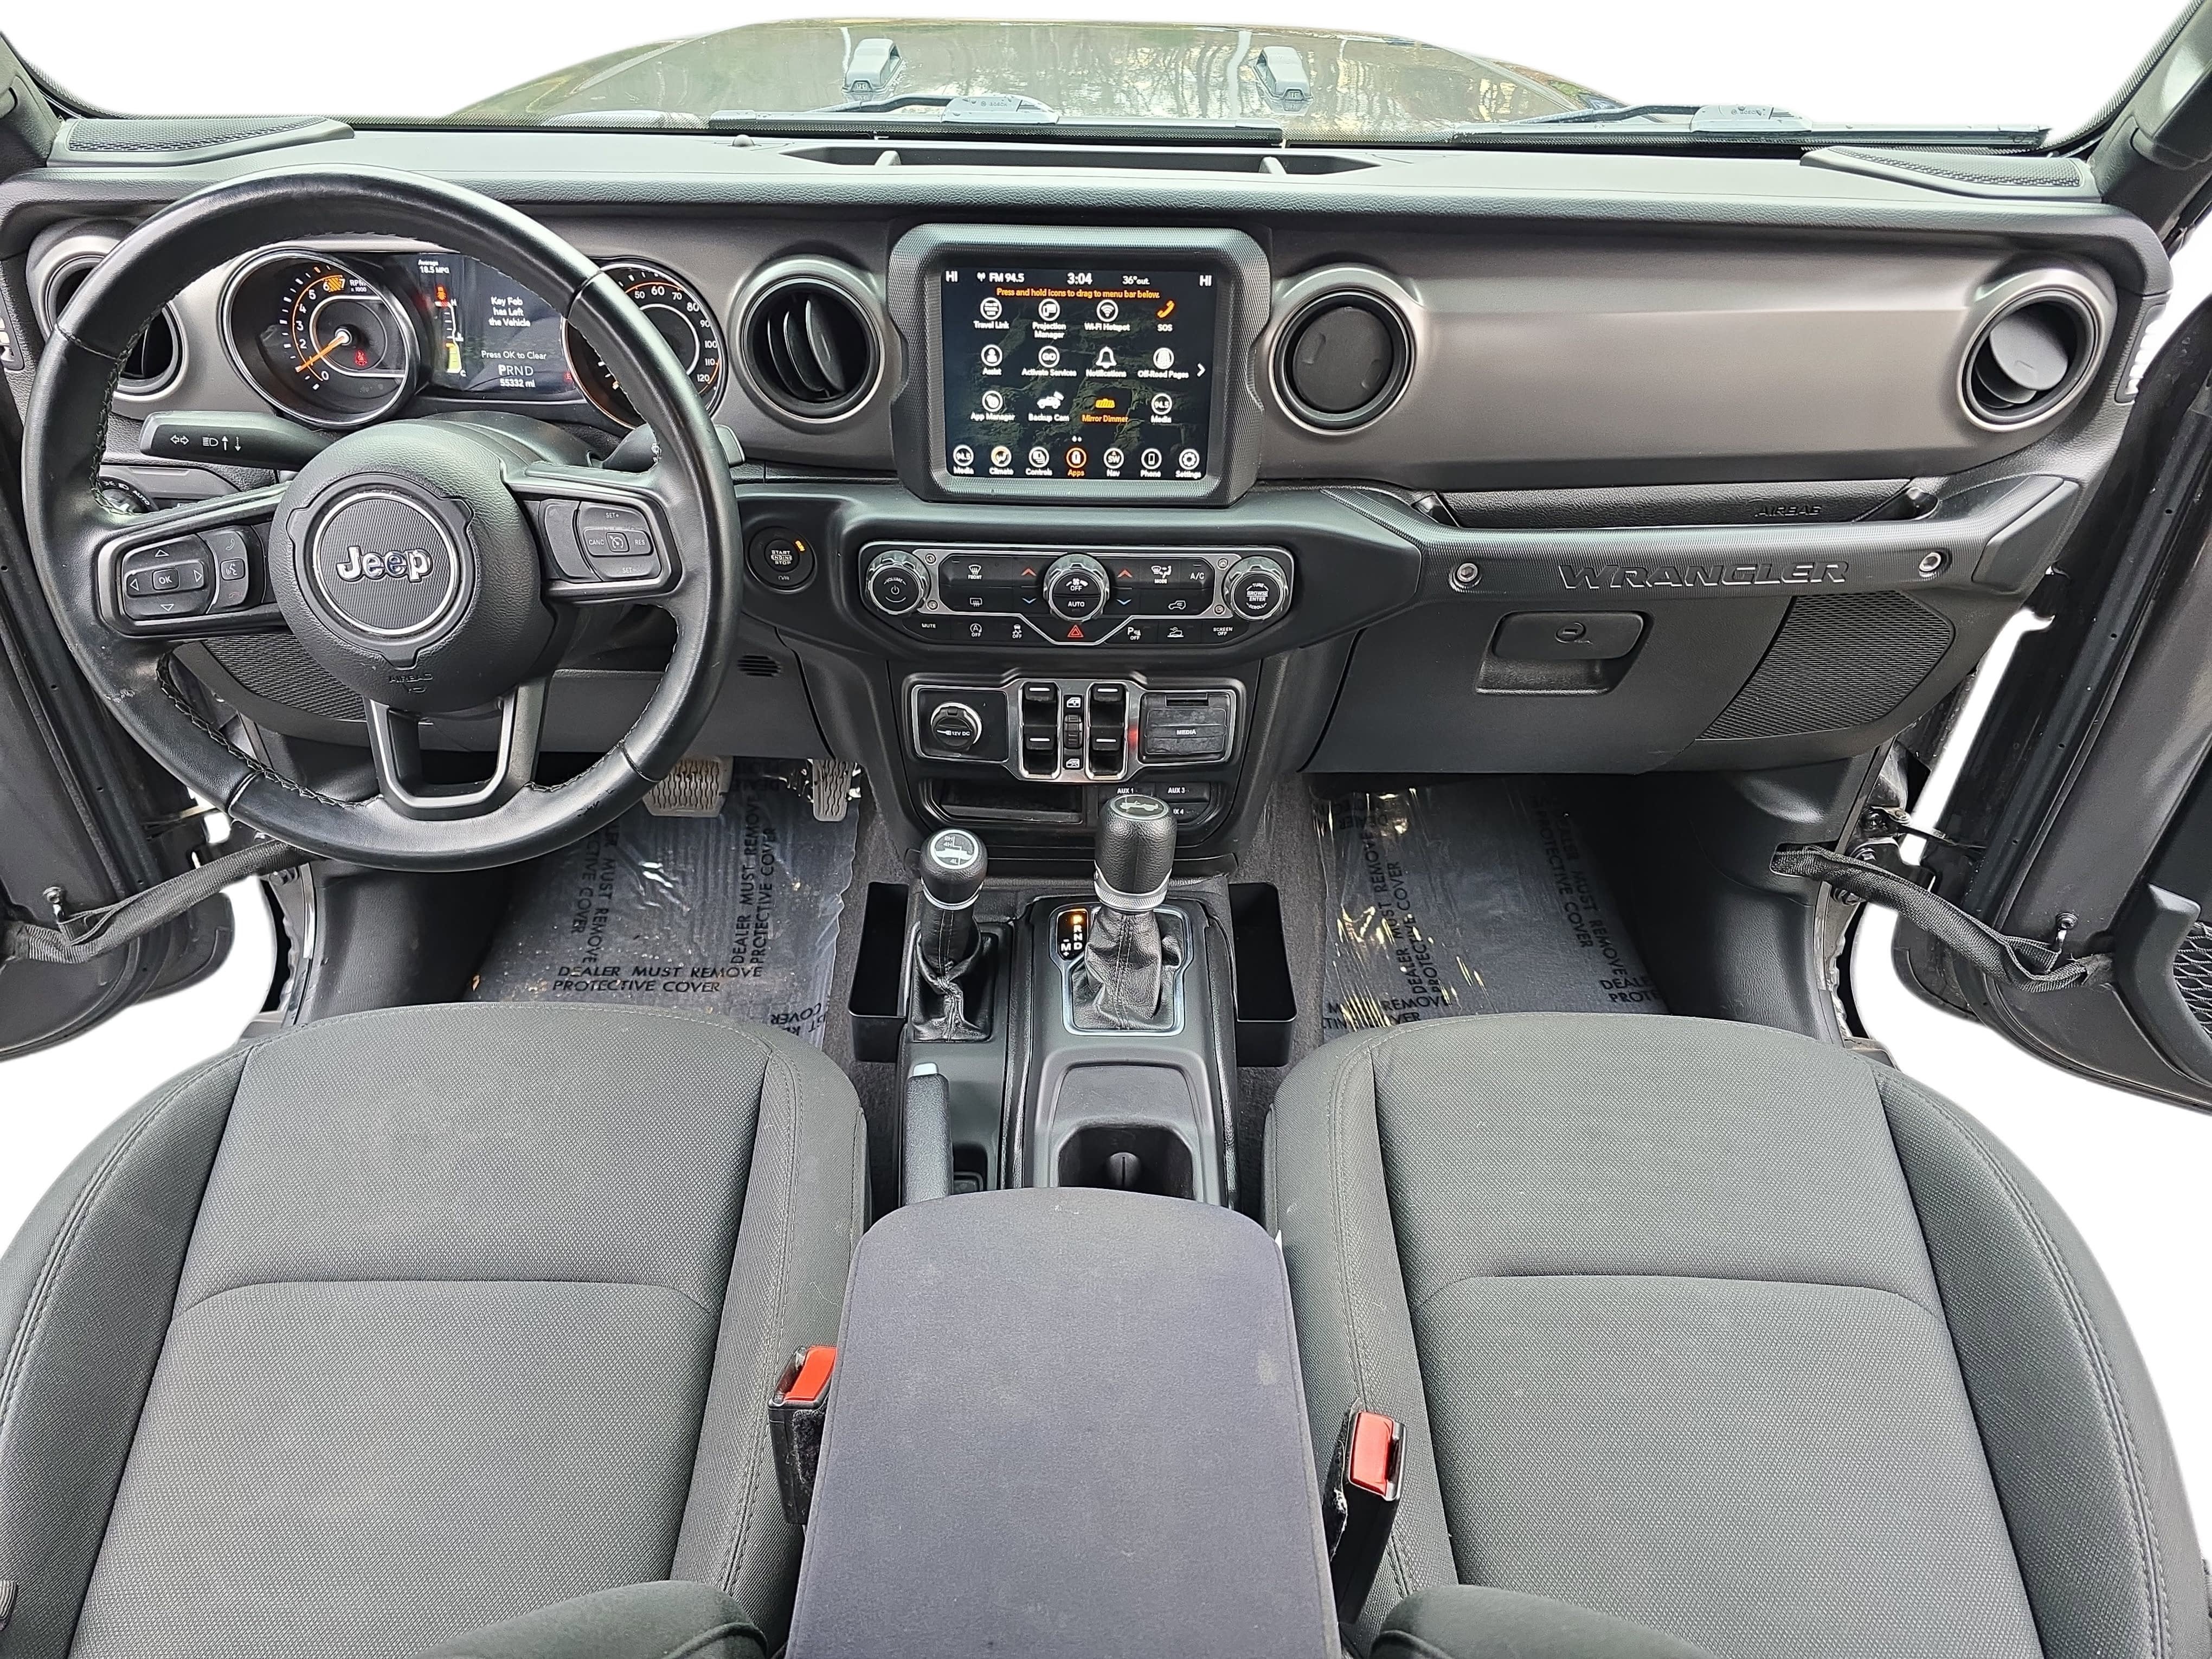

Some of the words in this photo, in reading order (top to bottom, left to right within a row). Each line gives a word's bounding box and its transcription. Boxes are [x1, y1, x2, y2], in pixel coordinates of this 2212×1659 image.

[946, 271, 958, 281] HI
[989, 273, 1003, 282] FM
[1005, 273, 1024, 282] 94.5
[1067, 273, 1092, 285] 3:04
[1199, 275, 1212, 286] HI
[323, 283, 330, 292] 6
[340, 278, 345, 288] 7
[308, 290, 316, 299] 5
[651, 286, 665, 295] 60
[996, 288, 1014, 296] Press
[1076, 290, 1092, 298] drag
[672, 292, 683, 300] 70
[491, 297, 506, 306] Key
[507, 297, 523, 305] Fob
[299, 303, 306, 314] 4
[493, 307, 507, 316] has
[508, 307, 524, 316] Left
[687, 302, 699, 312] 80
[296, 320, 304, 331] 3
[488, 318, 503, 326] the
[504, 318, 531, 327] Vehicle
[700, 320, 710, 328] 90
[995, 321, 1009, 329] Link
[1032, 322, 1066, 330] Projection
[1084, 323, 1102, 331] Wi-Fi
[1103, 323, 1130, 332] Hotspot
[1158, 324, 1173, 332] SOS
[1034, 330, 1065, 339] Manager
[300, 339, 307, 348] 2
[481, 350, 501, 359] Press
[527, 351, 547, 360] Clear
[321, 371, 329, 380] 0
[1021, 368, 1049, 376] Activate
[1086, 369, 1127, 378] Notifications
[1137, 370, 1167, 378] Off-Road
[1168, 371, 1189, 379] Pages
[697, 374, 710, 382] 120
[525, 380, 536, 388] mi
[970, 411, 985, 421] App
[986, 413, 1015, 422] Manager
[1028, 414, 1052, 422] Backup
[1108, 455, 1120, 464] SW
[953, 466, 974, 474] Media
[989, 467, 1014, 475] Climate
[1068, 469, 1084, 477] Apps
[1175, 471, 1201, 479] Settings
[132, 490, 150, 506] AUTO
[336, 545, 433, 583] Jeep
[158, 575, 172, 584] OK
[1558, 561, 1849, 589] WRANGLER
[744, 796, 760, 855] REMOVE
[761, 828, 776, 876] COVER
[599, 858, 615, 900] MUST
[739, 865, 755, 907] MUST
[1388, 862, 1410, 911] COVER
[571, 887, 594, 934] COVER
[750, 883, 773, 964] PROTECTIVE
[1073, 915, 1083, 924] P
[1379, 902, 1404, 939] MUST
[1571, 870, 1598, 911] MUST
[1589, 919, 1628, 975] REMOVE
[1565, 902, 1594, 948] COVER
[582, 908, 609, 963] REMOVE
[730, 914, 751, 964] DEALER
[1074, 933, 1083, 941] N
[1061, 943, 1071, 951] M
[558, 966, 620, 978] DEALER
[632, 966, 684, 978] MUST
[690, 966, 763, 978] REMOVE
[552, 980, 660, 992] PROTECTIVE
[663, 981, 721, 993] COVER
[770, 1002, 822, 1024] COVER
